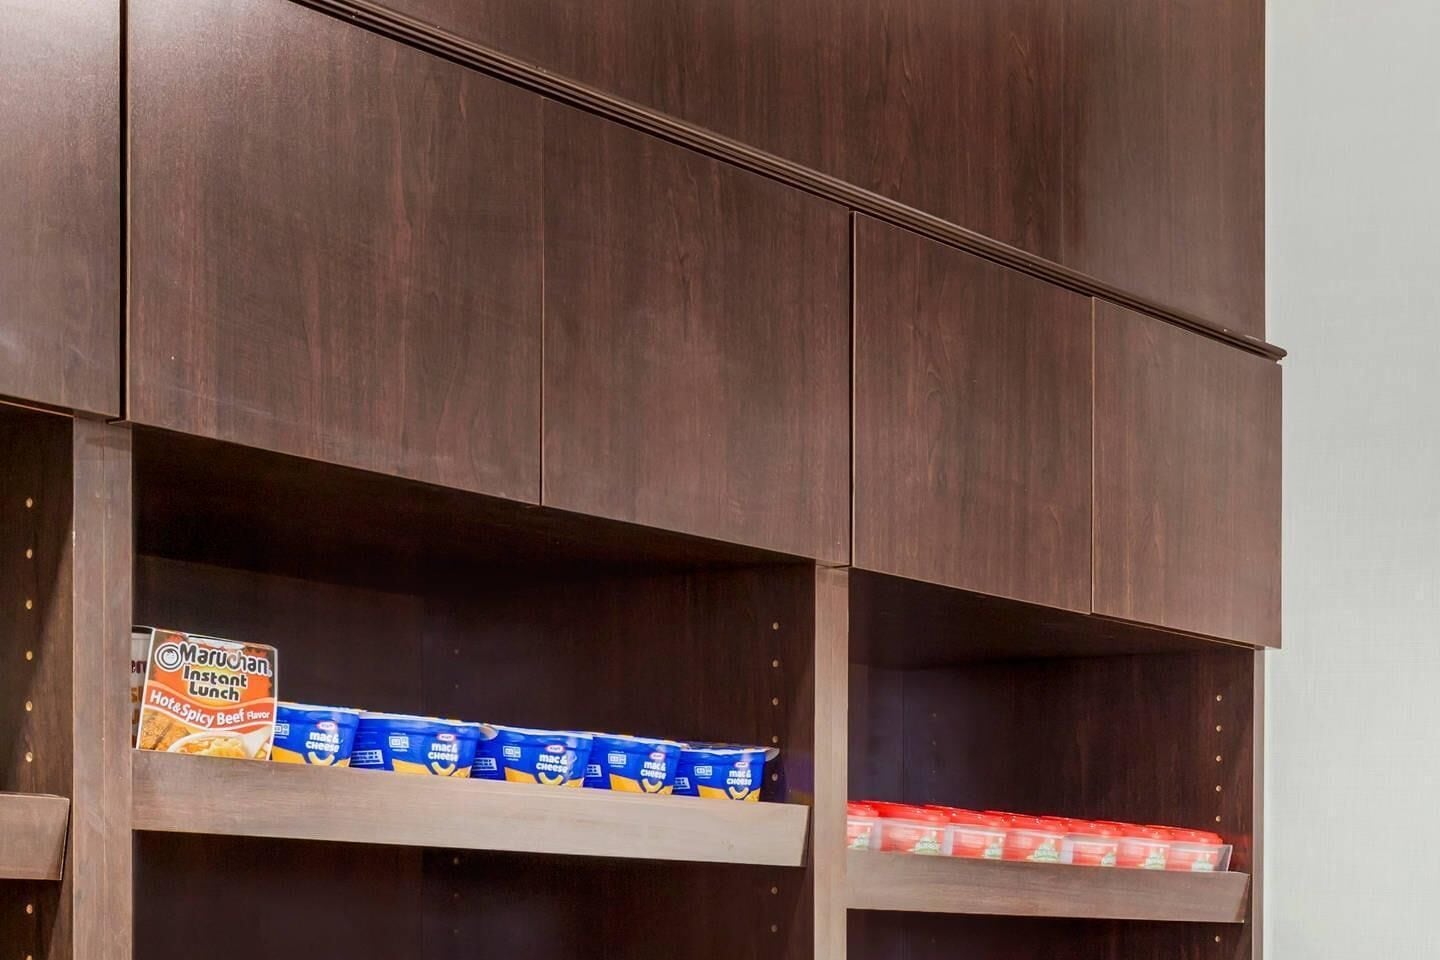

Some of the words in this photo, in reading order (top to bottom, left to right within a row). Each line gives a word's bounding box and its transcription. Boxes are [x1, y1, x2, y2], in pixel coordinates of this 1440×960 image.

[179, 643, 269, 675] Maruchan
[184, 665, 247, 687] Instant
[189, 682, 240, 701] Lunch
[217, 709, 244, 725] Beef
[247, 711, 270, 720] Flavor
